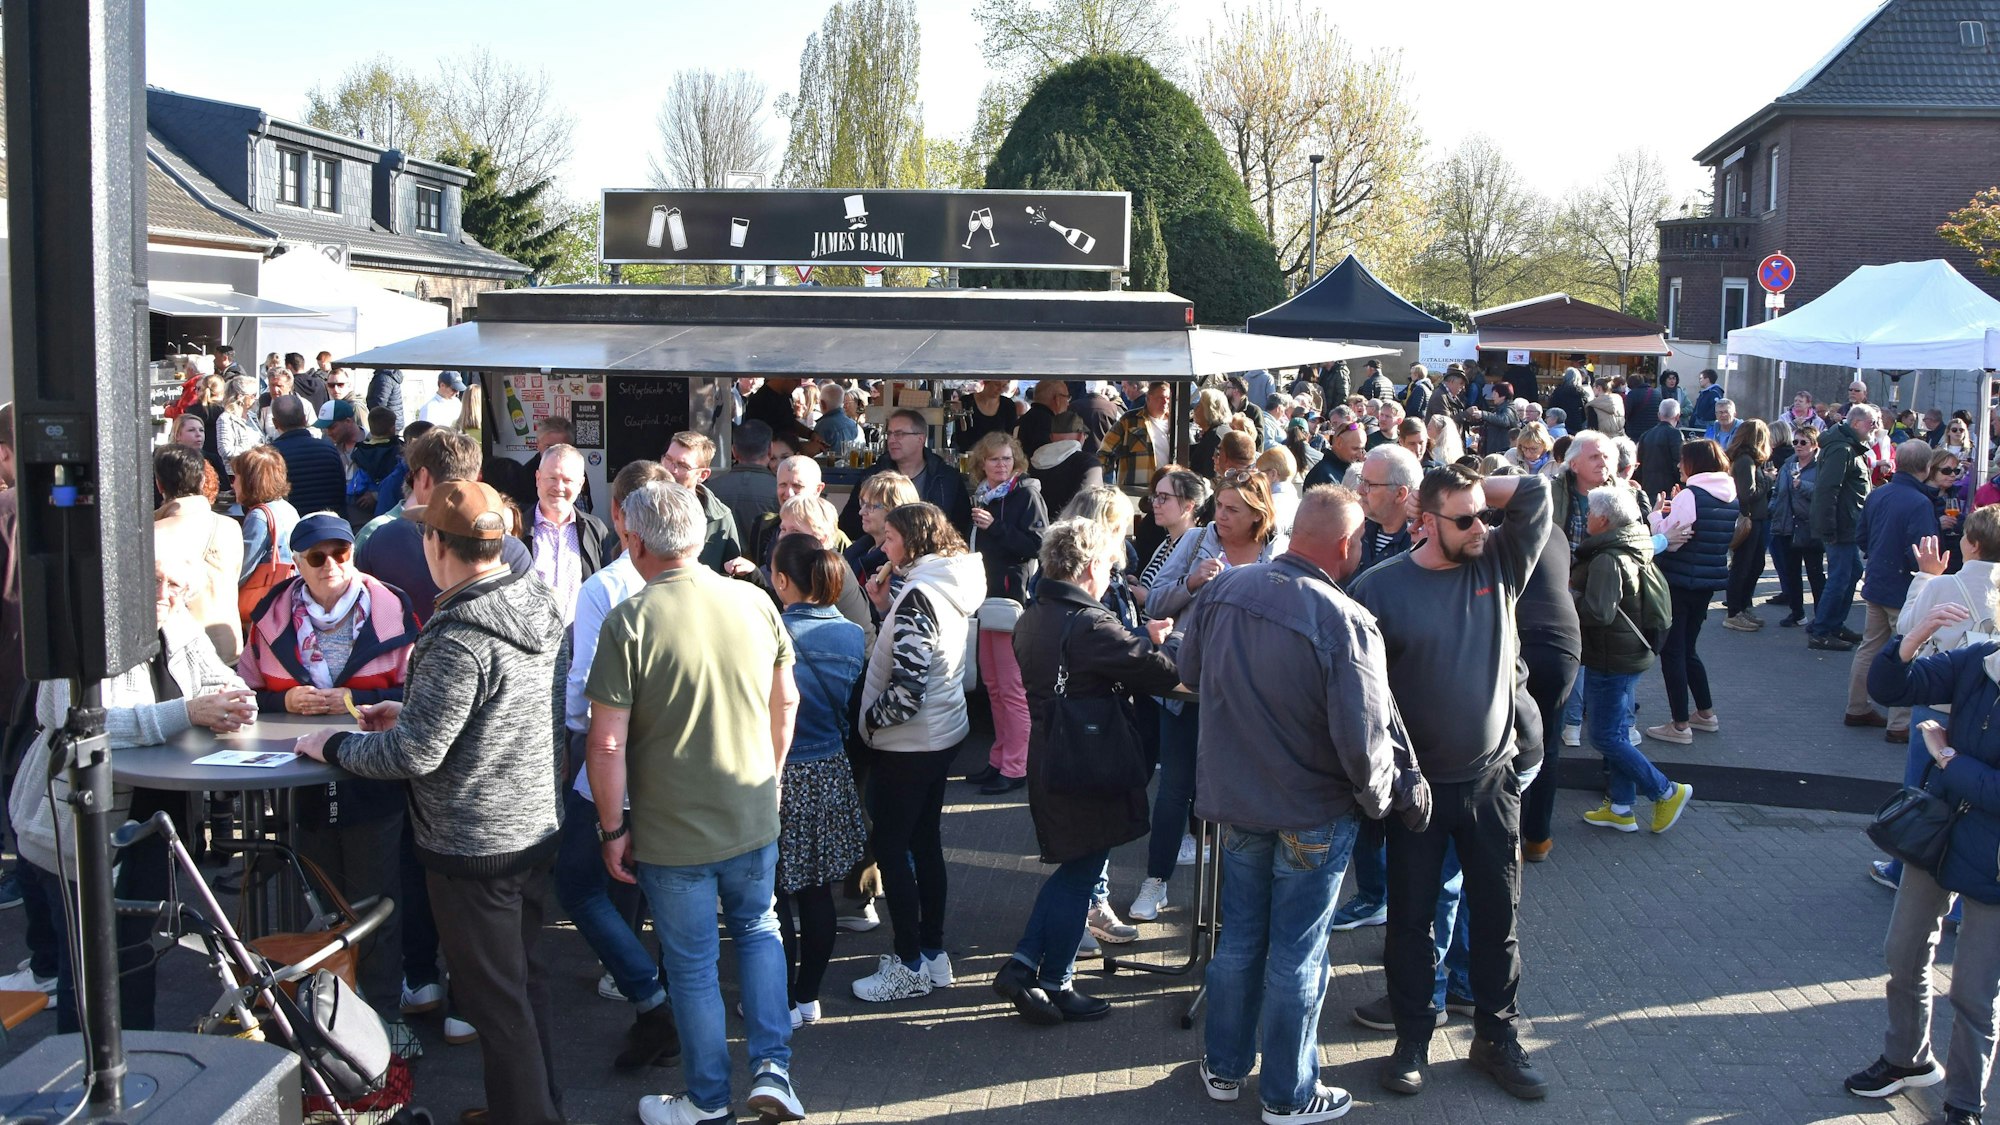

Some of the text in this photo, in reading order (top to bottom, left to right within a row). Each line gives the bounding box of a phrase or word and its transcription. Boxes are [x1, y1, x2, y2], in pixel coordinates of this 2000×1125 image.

[811, 232, 905, 260] JAMES BARON
[328, 781, 337, 797] RTS
